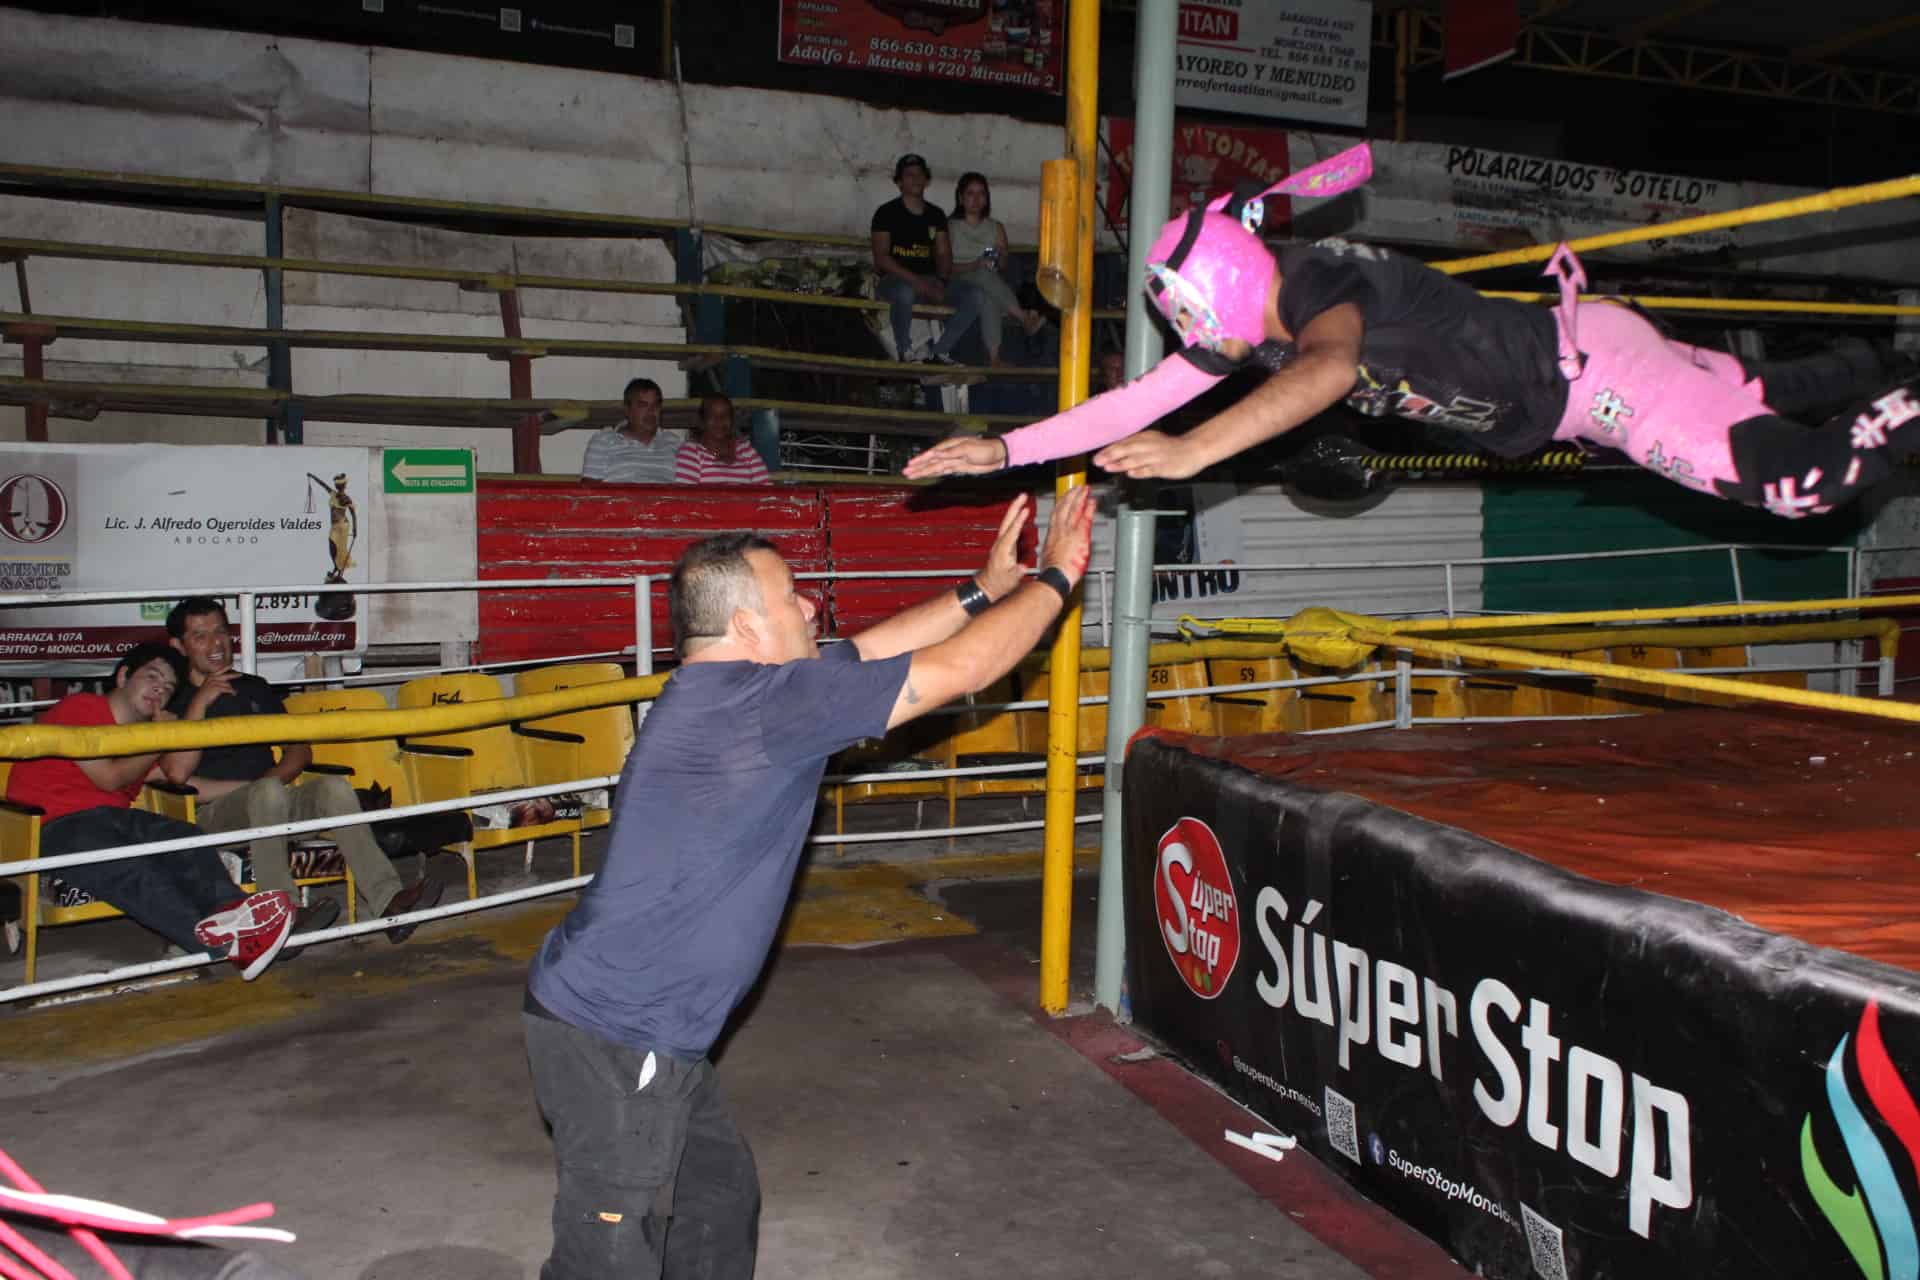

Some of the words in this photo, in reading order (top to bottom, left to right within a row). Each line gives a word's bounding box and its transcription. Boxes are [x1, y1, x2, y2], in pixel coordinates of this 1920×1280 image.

[789, 44, 843, 64] Adolfo
[847, 50, 861, 65] L.
[867, 53, 922, 72] Mateos
[969, 65, 1040, 86] Miravalle
[1254, 63, 1265, 81] Y
[1269, 66, 1354, 92] MENUDEO
[1445, 147, 1600, 192] POLARIZADOS
[103, 516, 129, 530] Lic.
[134, 517, 146, 530] J.
[151, 516, 202, 532] Alfredo
[206, 517, 275, 532] Oyervides
[280, 518, 322, 531] Valdes
[173, 536, 259, 545] ABOGADO
[57, 632, 83, 642] 107A
[1151, 669, 1168, 684] 58
[1240, 667, 1255, 681] 59
[431, 690, 464, 705] 154
[1233, 1055, 1321, 1117] @superstop.mexico
